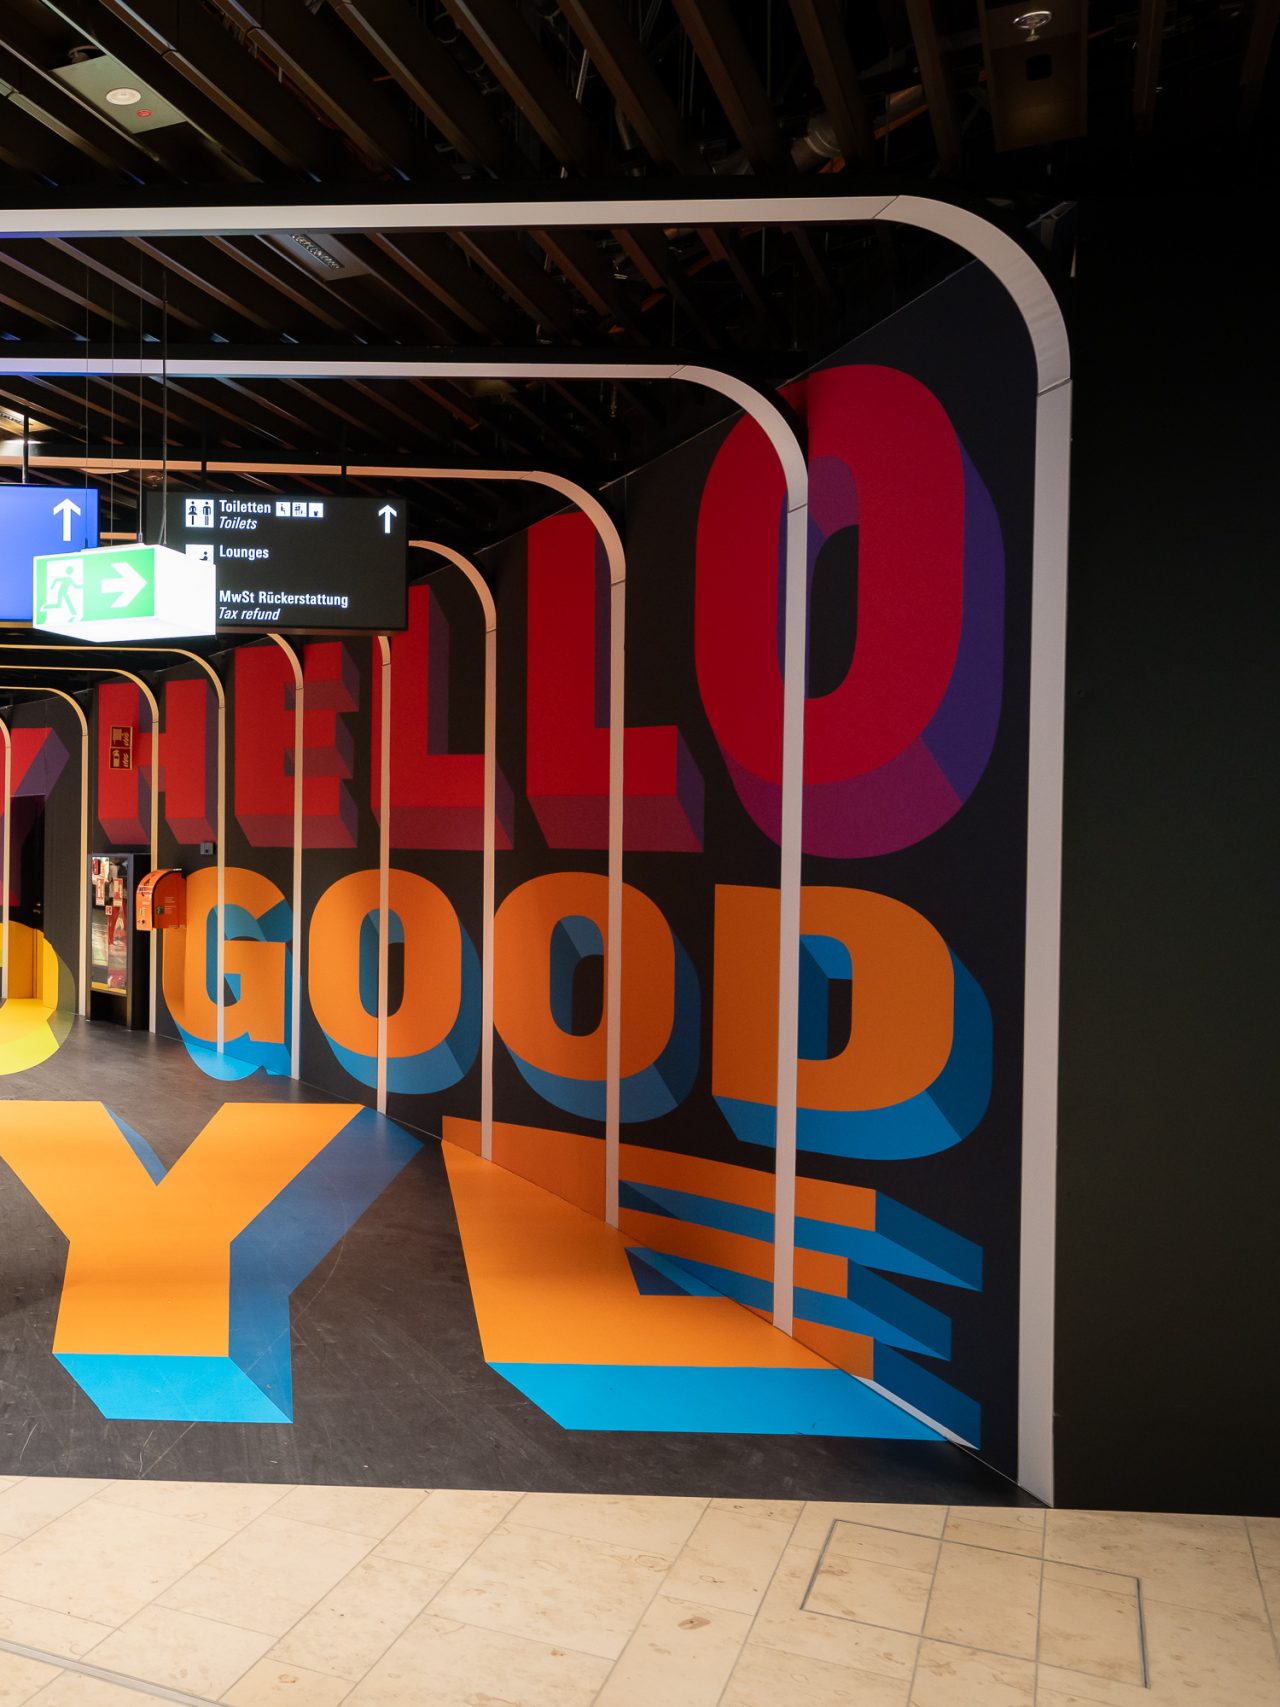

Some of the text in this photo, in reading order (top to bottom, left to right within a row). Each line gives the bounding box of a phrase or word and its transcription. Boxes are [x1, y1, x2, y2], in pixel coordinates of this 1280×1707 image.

[219, 499, 271, 513] Toiletten
[218, 516, 258, 530] Toilets
[219, 545, 270, 561] Lounges
[219, 590, 349, 608] MwSt Rückerstattung
[98, 364, 1006, 858] HELLO
[218, 606, 281, 622] Tax refund
[162, 866, 993, 1160] GOOD
